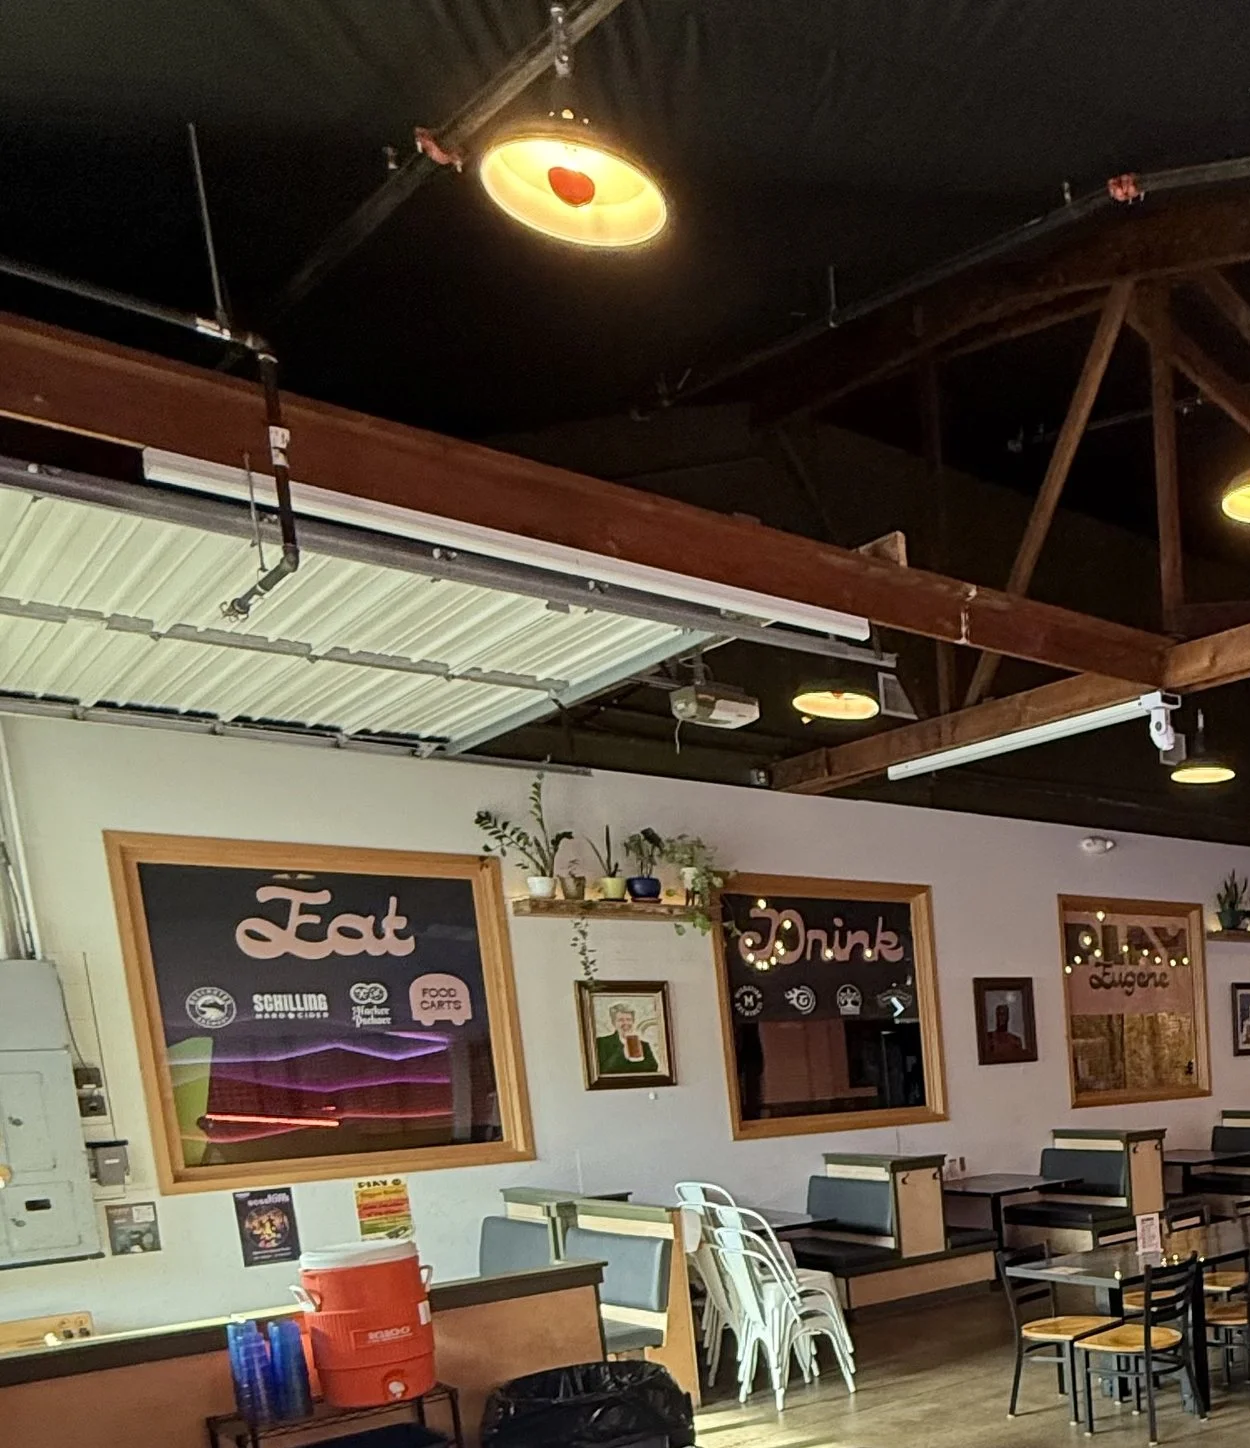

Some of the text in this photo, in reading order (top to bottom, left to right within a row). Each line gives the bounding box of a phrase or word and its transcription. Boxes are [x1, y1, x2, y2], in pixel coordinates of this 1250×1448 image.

[235, 885, 415, 959] Eat
[738, 907, 904, 965] Drink
[1089, 962, 1169, 997] Eugene
[252, 993, 329, 1012] SCHILLING
[421, 988, 457, 998] FOOD
[420, 1000, 462, 1011] CARTS
[367, 1325, 411, 1340] IGLOO
